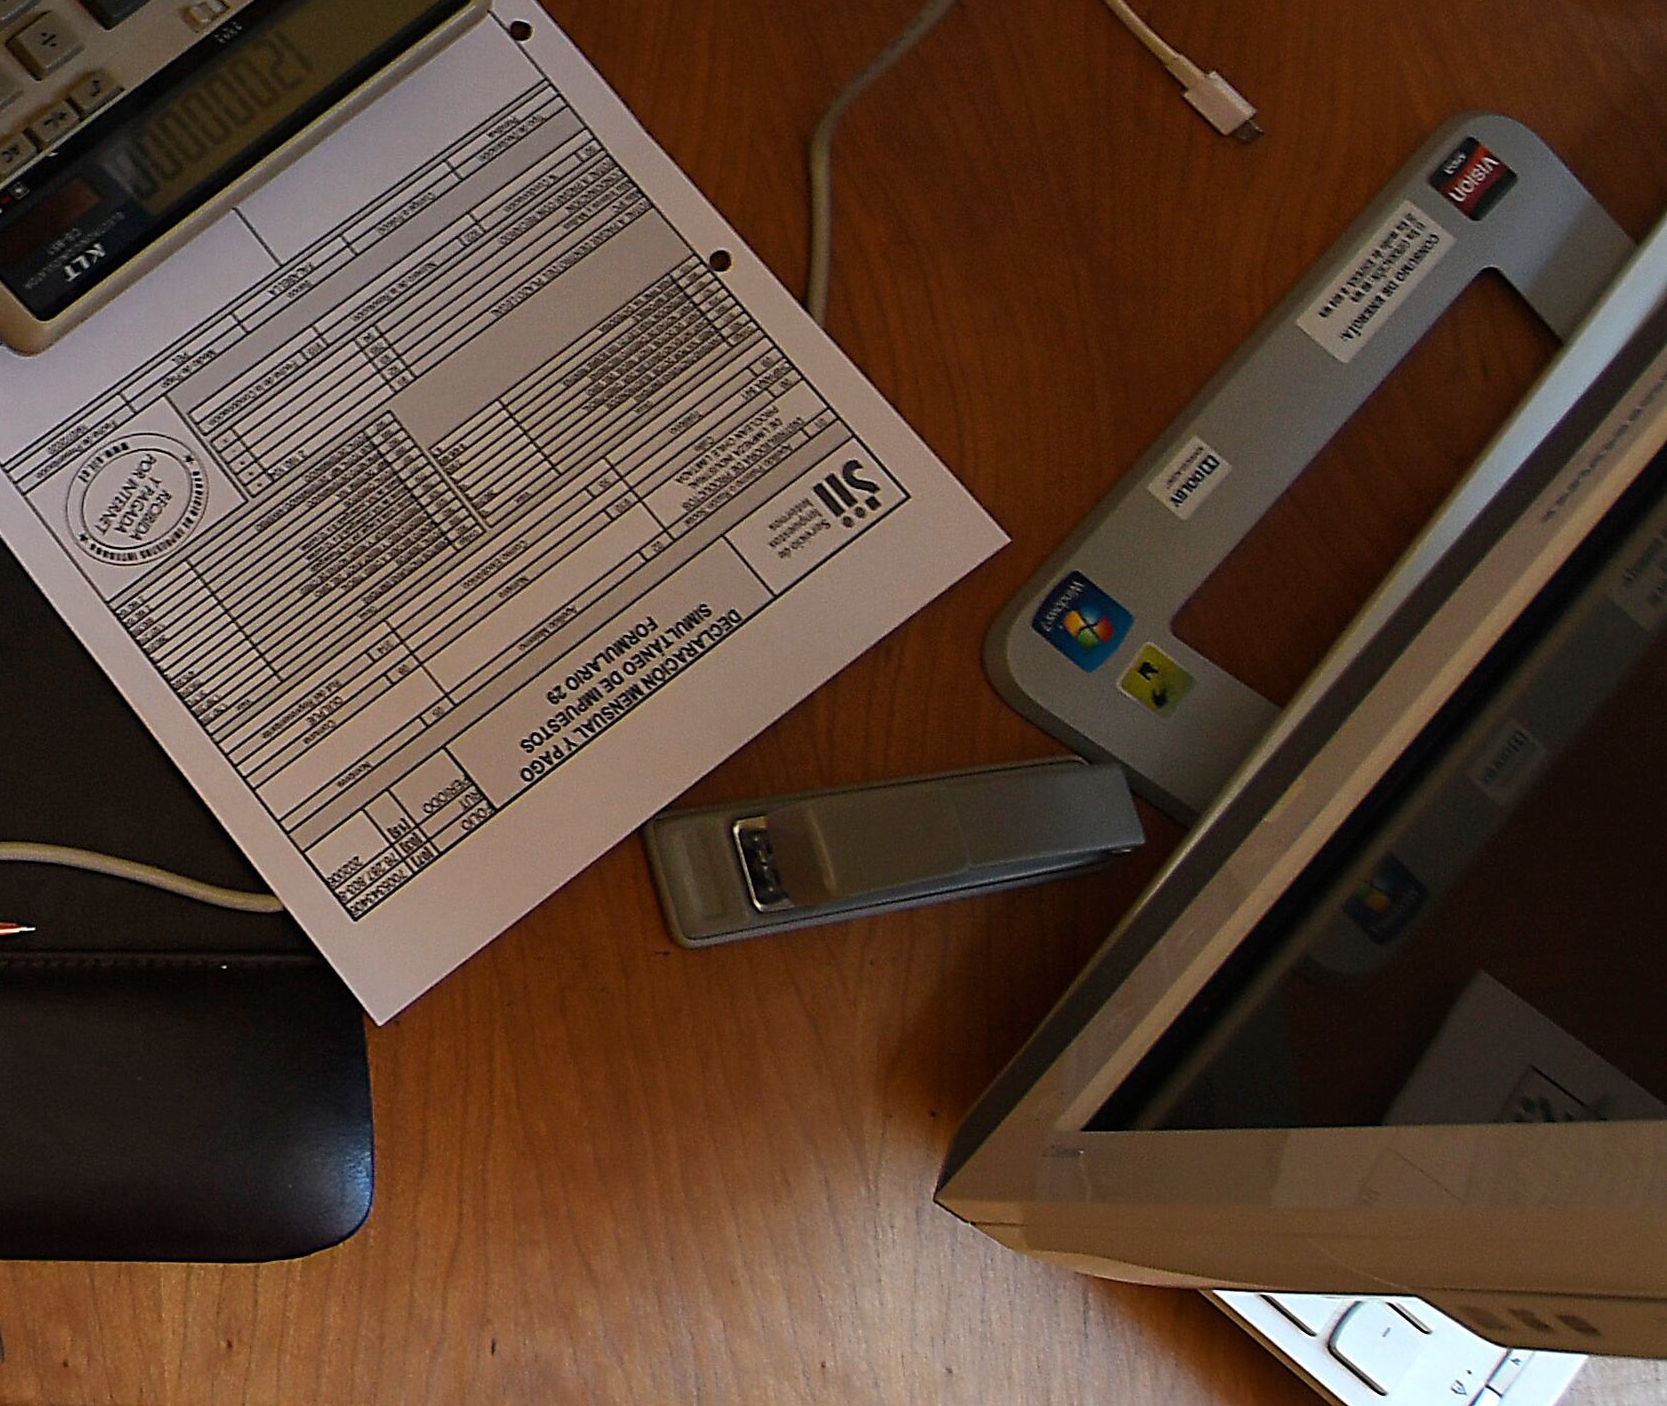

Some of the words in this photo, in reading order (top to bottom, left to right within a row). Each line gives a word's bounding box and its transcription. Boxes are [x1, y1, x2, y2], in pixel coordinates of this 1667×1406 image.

[64, 243, 104, 281] KLT
[1396, 234, 1438, 280] CONSUMO
[1382, 280, 1398, 296] DE
[132, 453, 156, 478] POR
[96, 479, 137, 533] INTERNET
[115, 485, 153, 532] PAGADA
[130, 490, 171, 539] RECIBIDA
[769, 498, 812, 530] Internos
[769, 508, 821, 547] Impuestos
[790, 519, 830, 549] Servicio
[778, 547, 790, 558] de
[566, 617, 656, 689] FORMULARIO
[623, 604, 710, 674] SIMULTÁNEO
[642, 610, 740, 688] DECLARACIÓN
[547, 685, 566, 704] 29
[599, 670, 624, 692] DE
[521, 688, 601, 752] IMPUESTOS
[573, 685, 641, 739] MENSUAL
[520, 745, 563, 781] PAGO
[562, 737, 577, 751] Y
